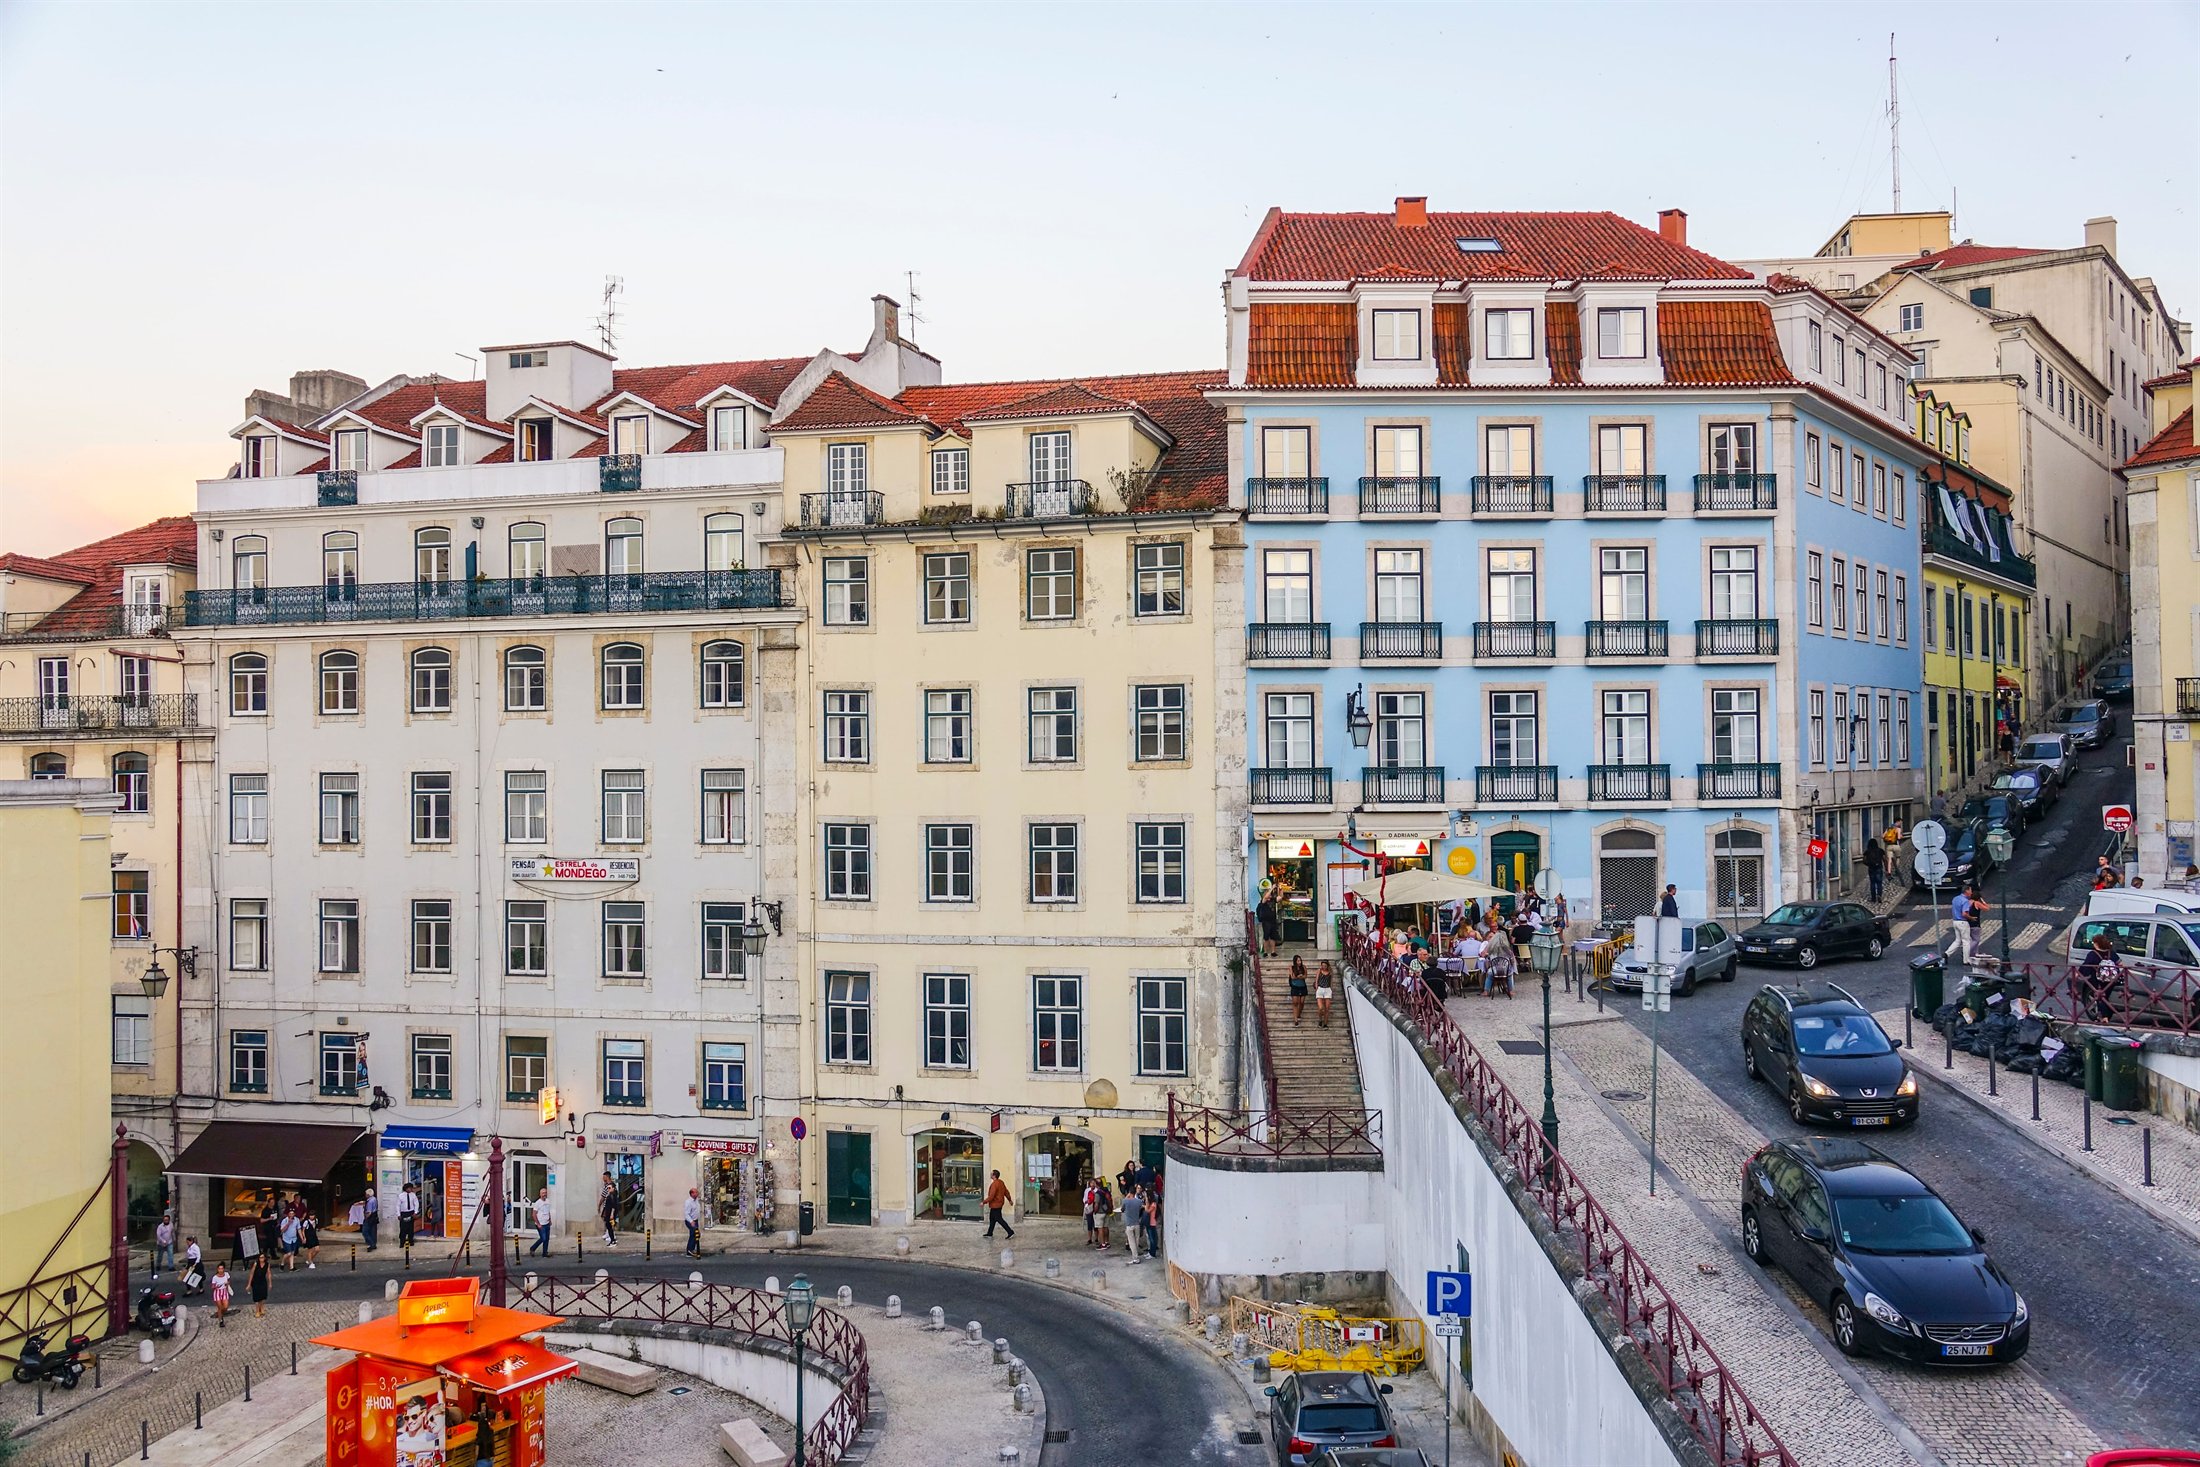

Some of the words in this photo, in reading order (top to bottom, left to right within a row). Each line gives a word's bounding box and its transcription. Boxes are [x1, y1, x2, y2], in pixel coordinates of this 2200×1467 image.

[555, 868, 606, 878] MONDEGO
[422, 1142, 449, 1150] TOURS
[698, 1141, 727, 1149] SOUVENIRS
[1436, 1276, 1461, 1312] P
